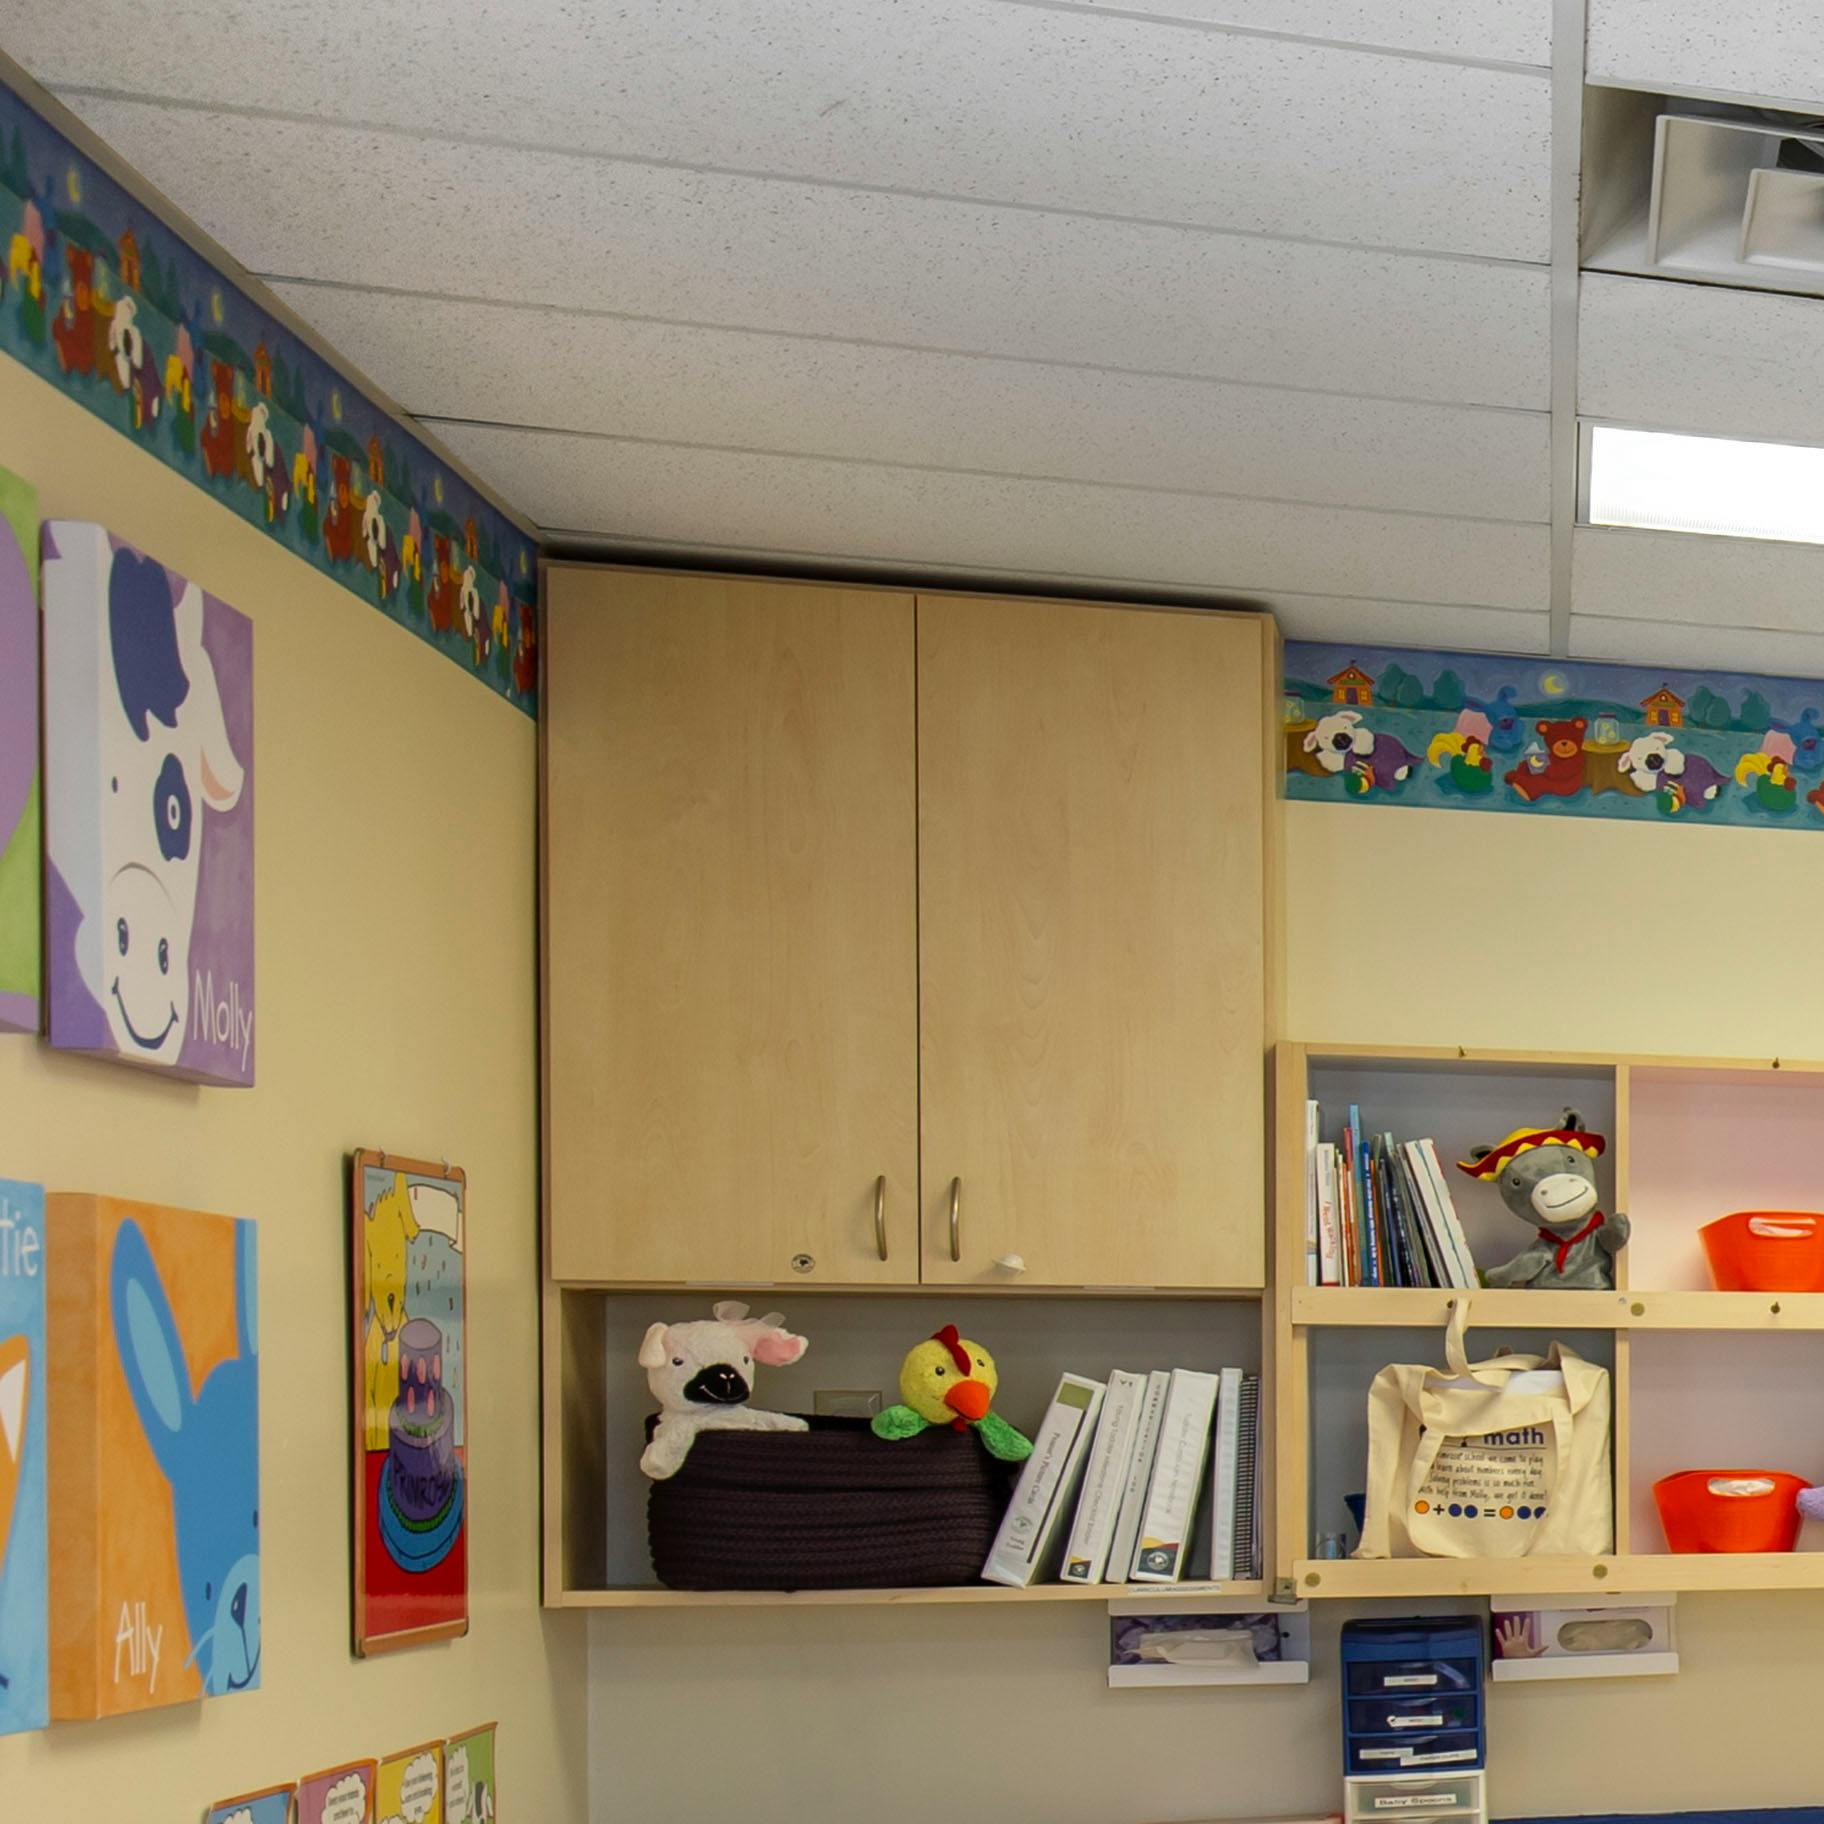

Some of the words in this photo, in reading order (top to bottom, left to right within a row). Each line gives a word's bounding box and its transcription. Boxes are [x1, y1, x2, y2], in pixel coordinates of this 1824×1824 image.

[193, 968, 253, 1073] Molly
[1484, 1427, 1544, 1446] math
[114, 1600, 163, 1694] Ally
[1379, 1798, 1408, 1806] Baby
[1411, 1795, 1453, 1806] Spoons
